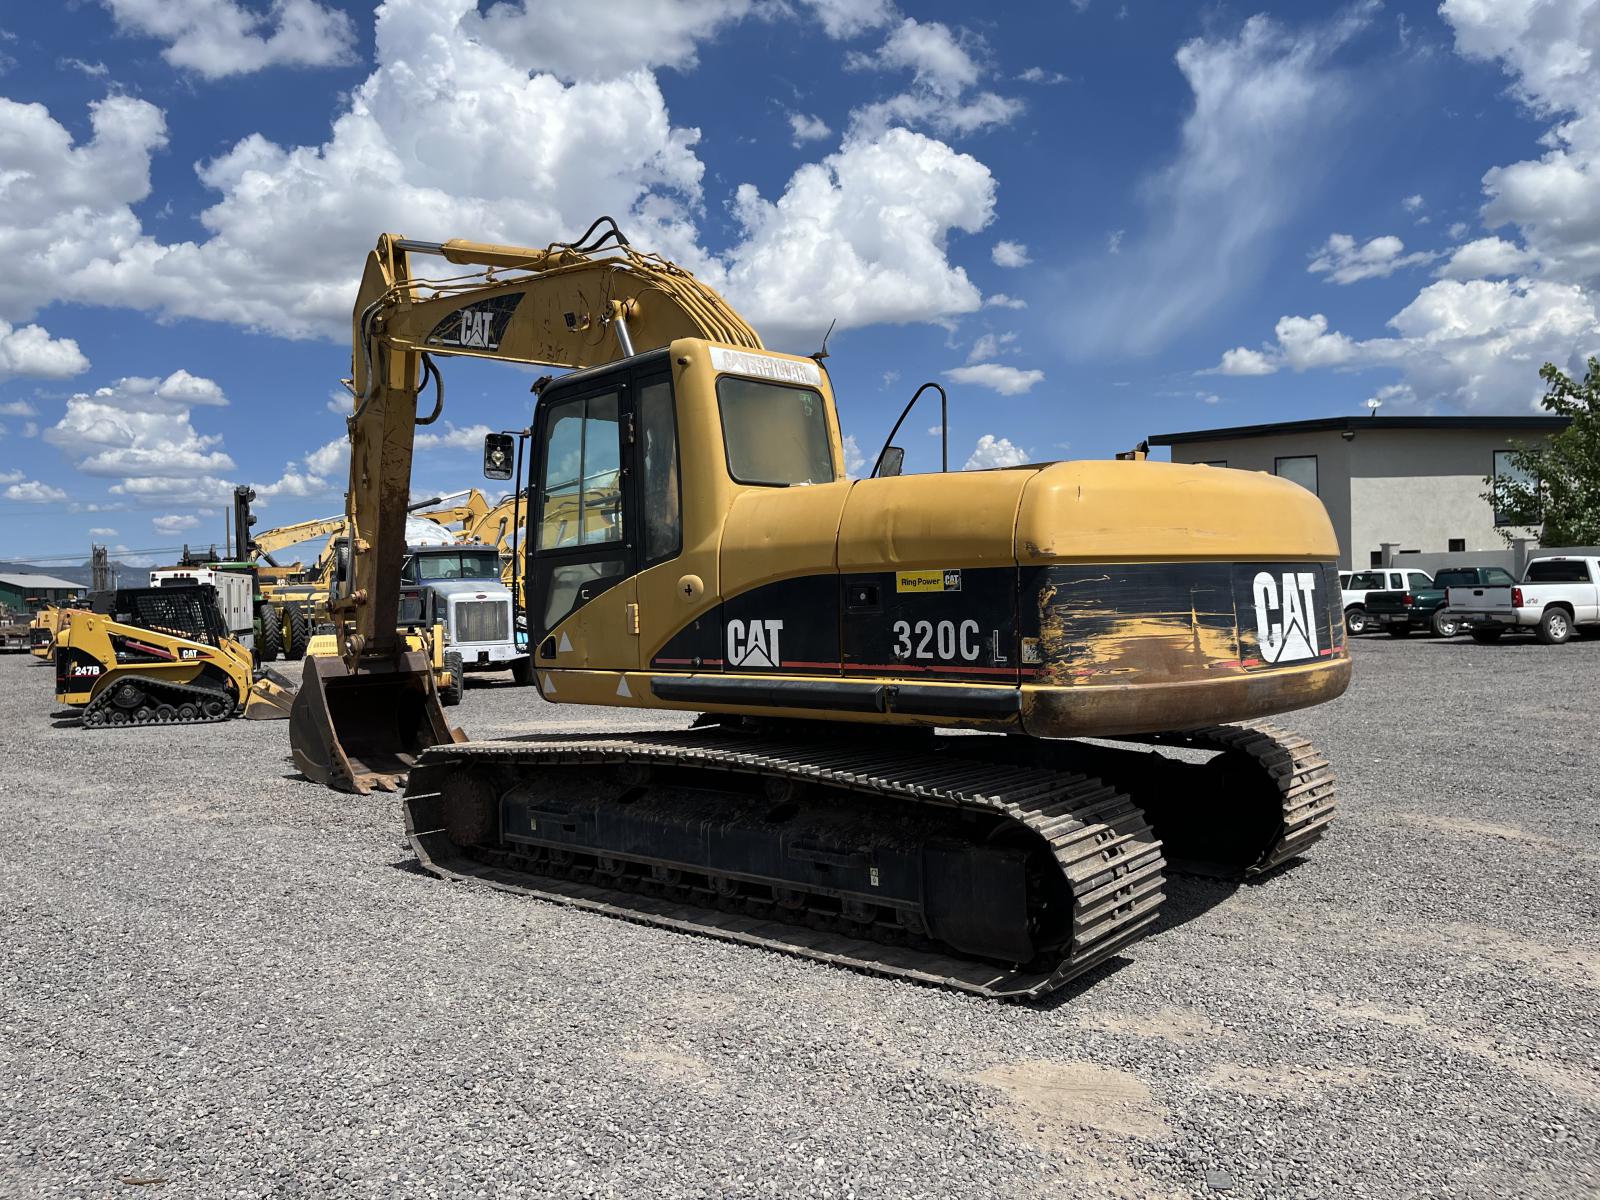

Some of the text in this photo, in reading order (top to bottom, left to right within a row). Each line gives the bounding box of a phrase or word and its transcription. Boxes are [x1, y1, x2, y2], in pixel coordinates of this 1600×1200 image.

[461, 310, 494, 347] CAT
[901, 577, 941, 587] Ring Power
[944, 574, 959, 585] CAT
[1253, 571, 1319, 663] CAT
[727, 619, 783, 667] CAT
[893, 619, 980, 661] 320C
[993, 629, 1008, 662] L
[182, 649, 198, 659] CAT
[75, 665, 100, 676] 247B
